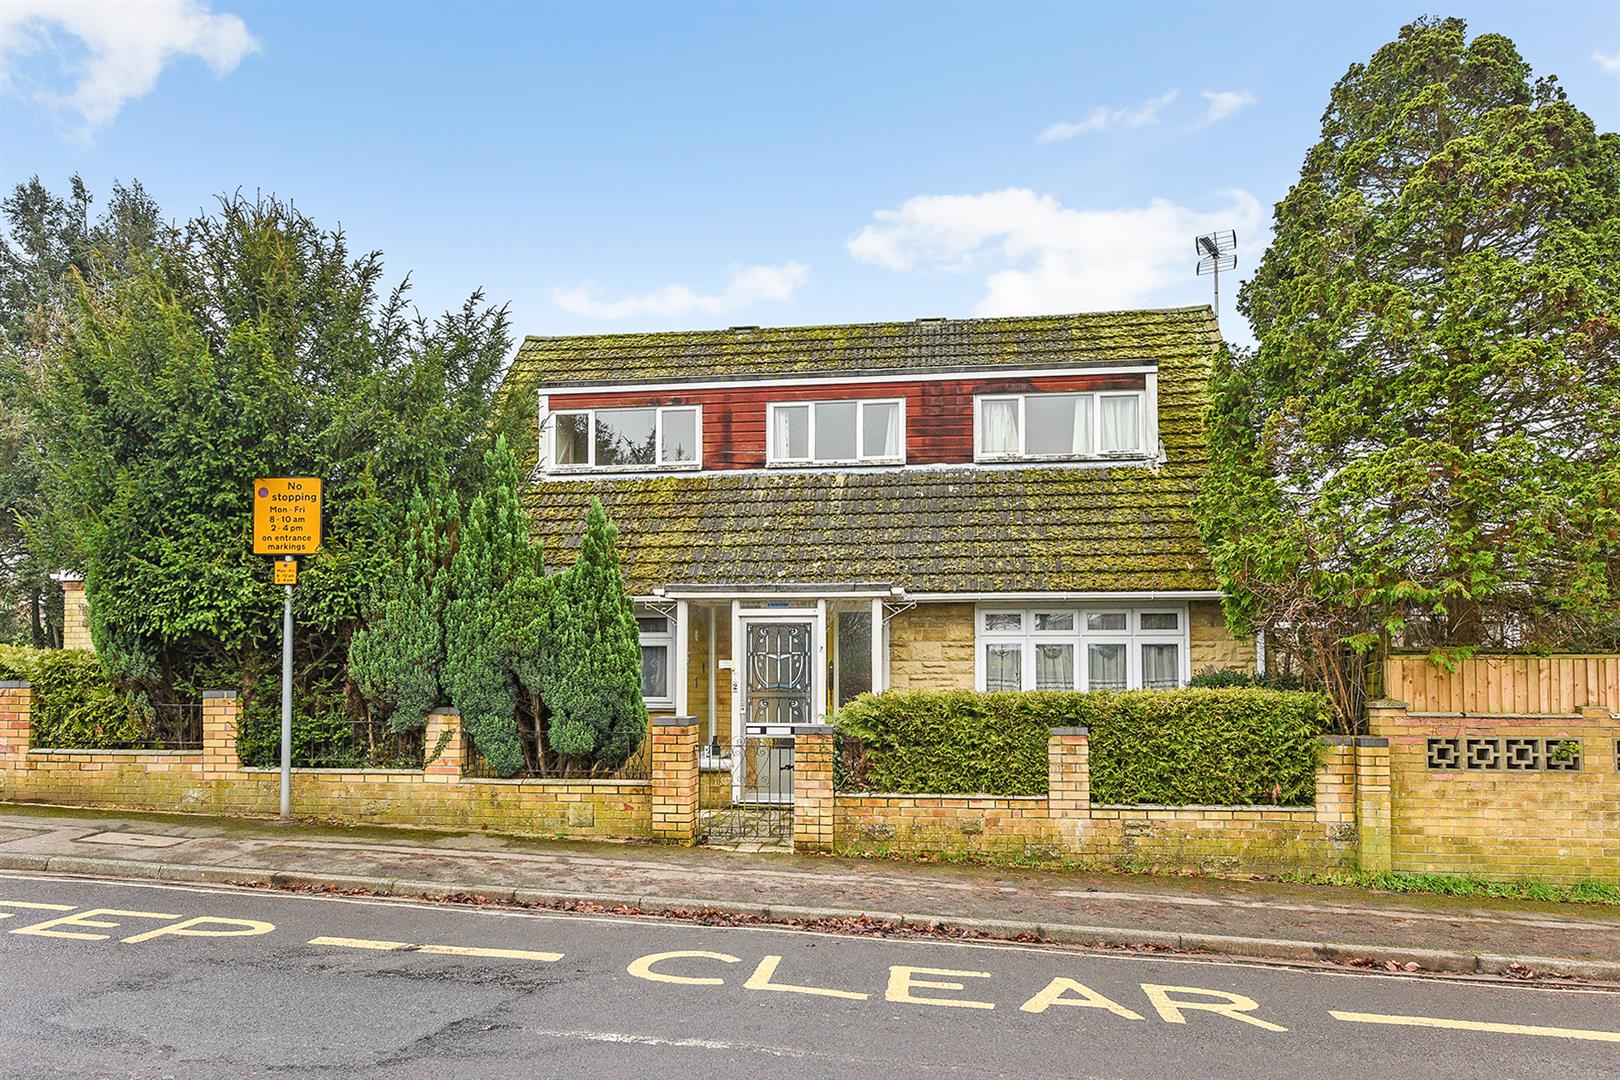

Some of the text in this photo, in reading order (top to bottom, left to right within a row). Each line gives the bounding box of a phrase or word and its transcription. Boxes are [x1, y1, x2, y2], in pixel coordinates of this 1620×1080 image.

[288, 482, 302, 490] No
[272, 493, 317, 503] stopping
[268, 544, 306, 552] markings
[627, 950, 1288, 1032] CLEAR
